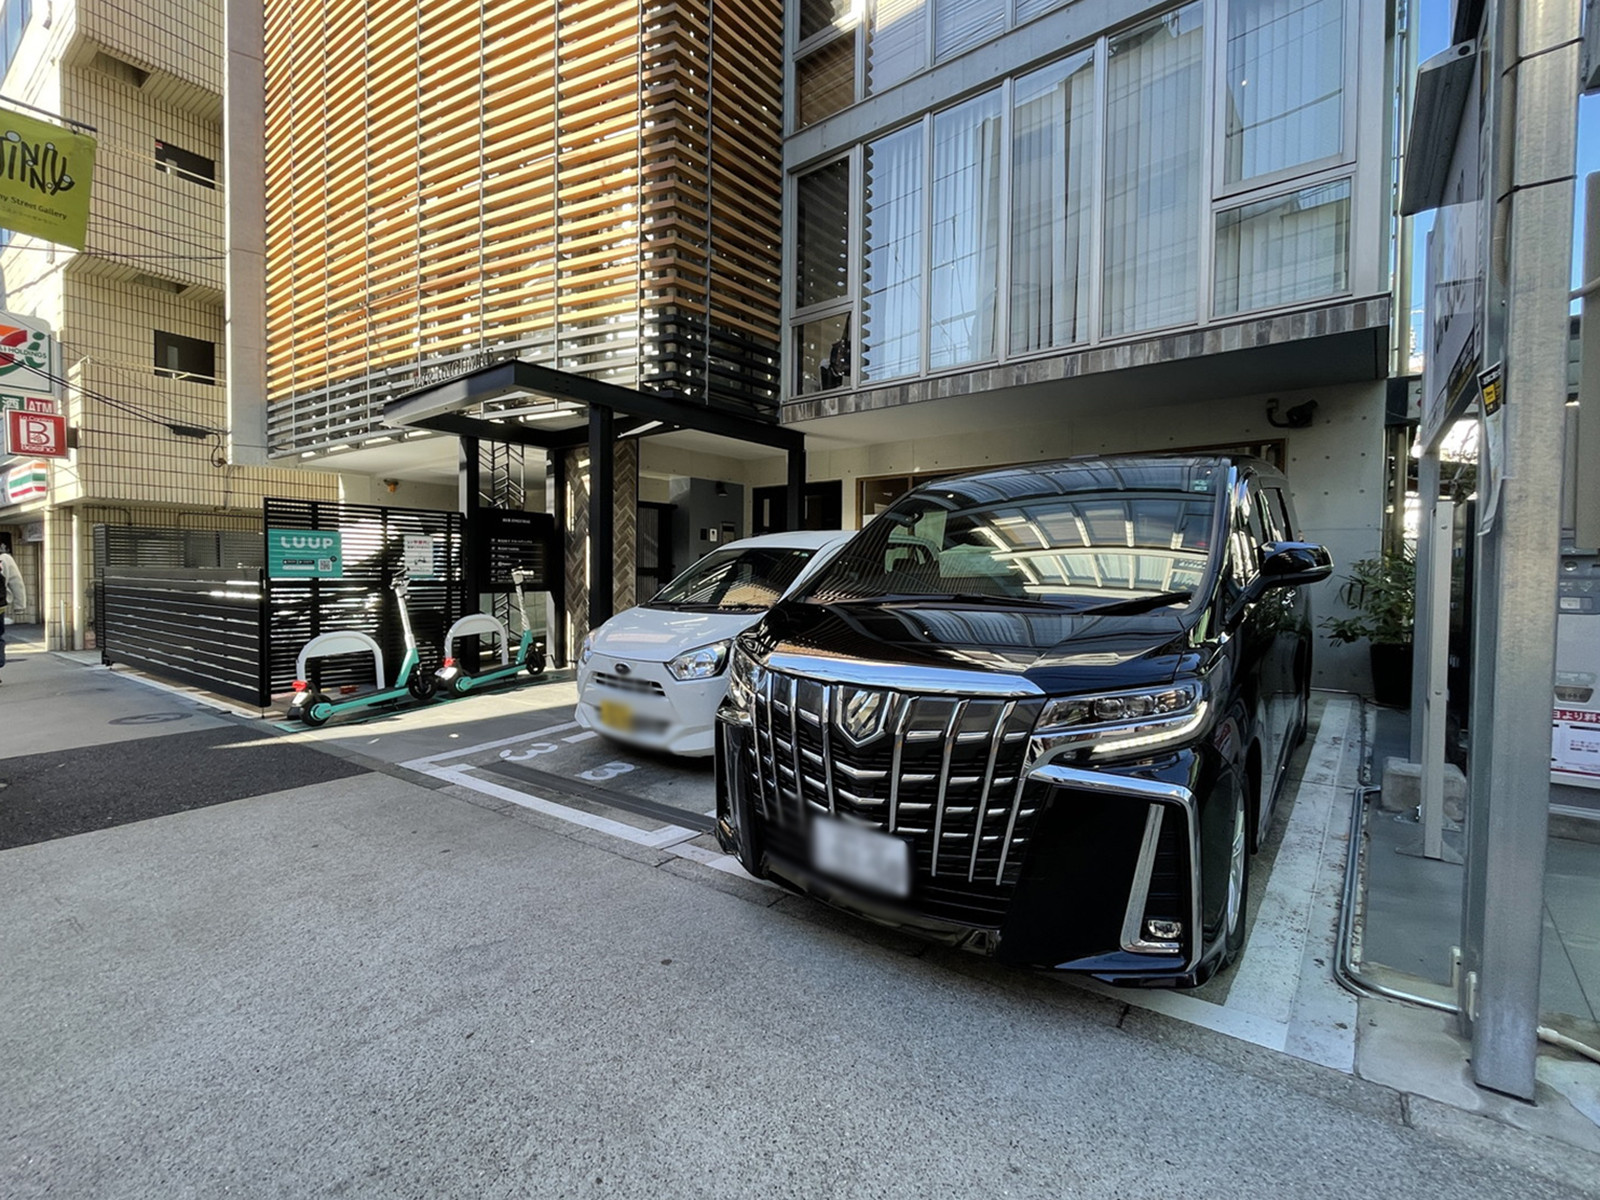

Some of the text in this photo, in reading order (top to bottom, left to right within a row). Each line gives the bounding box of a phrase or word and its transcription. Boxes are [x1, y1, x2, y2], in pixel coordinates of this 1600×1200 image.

[11, 197, 36, 210] Street
[38, 205, 67, 220] Gallery
[8, 347, 47, 359] HOLDINGS
[28, 400, 53, 414] ATM
[27, 420, 50, 447] B
[280, 536, 334, 549] LUUP
